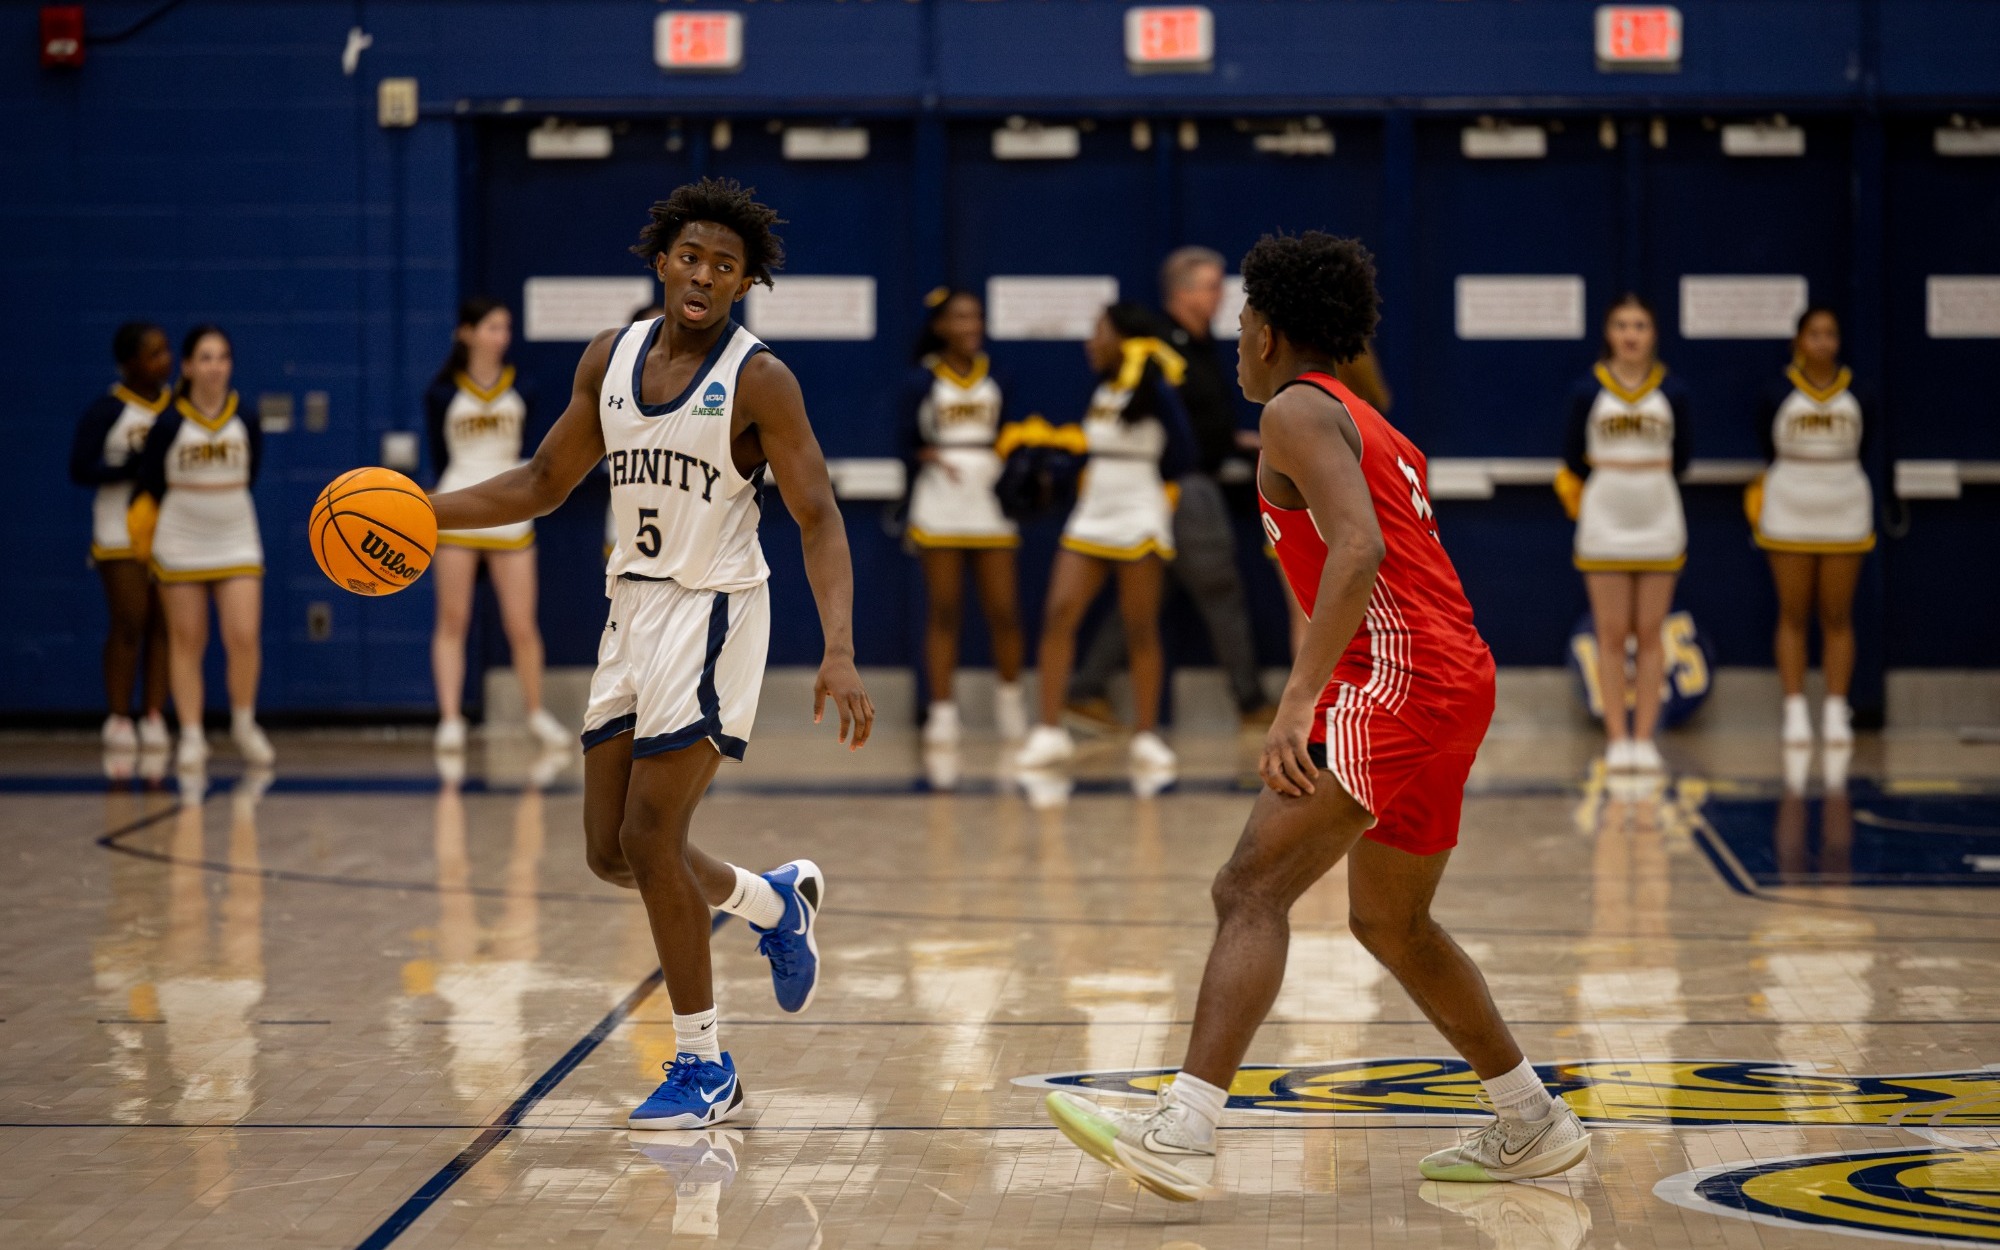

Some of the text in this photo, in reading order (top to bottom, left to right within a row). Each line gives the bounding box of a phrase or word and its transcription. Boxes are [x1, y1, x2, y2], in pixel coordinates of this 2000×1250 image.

[697, 407, 726, 417] NESCAC
[607, 448, 721, 504] RINITY
[635, 507, 662, 558] 5
